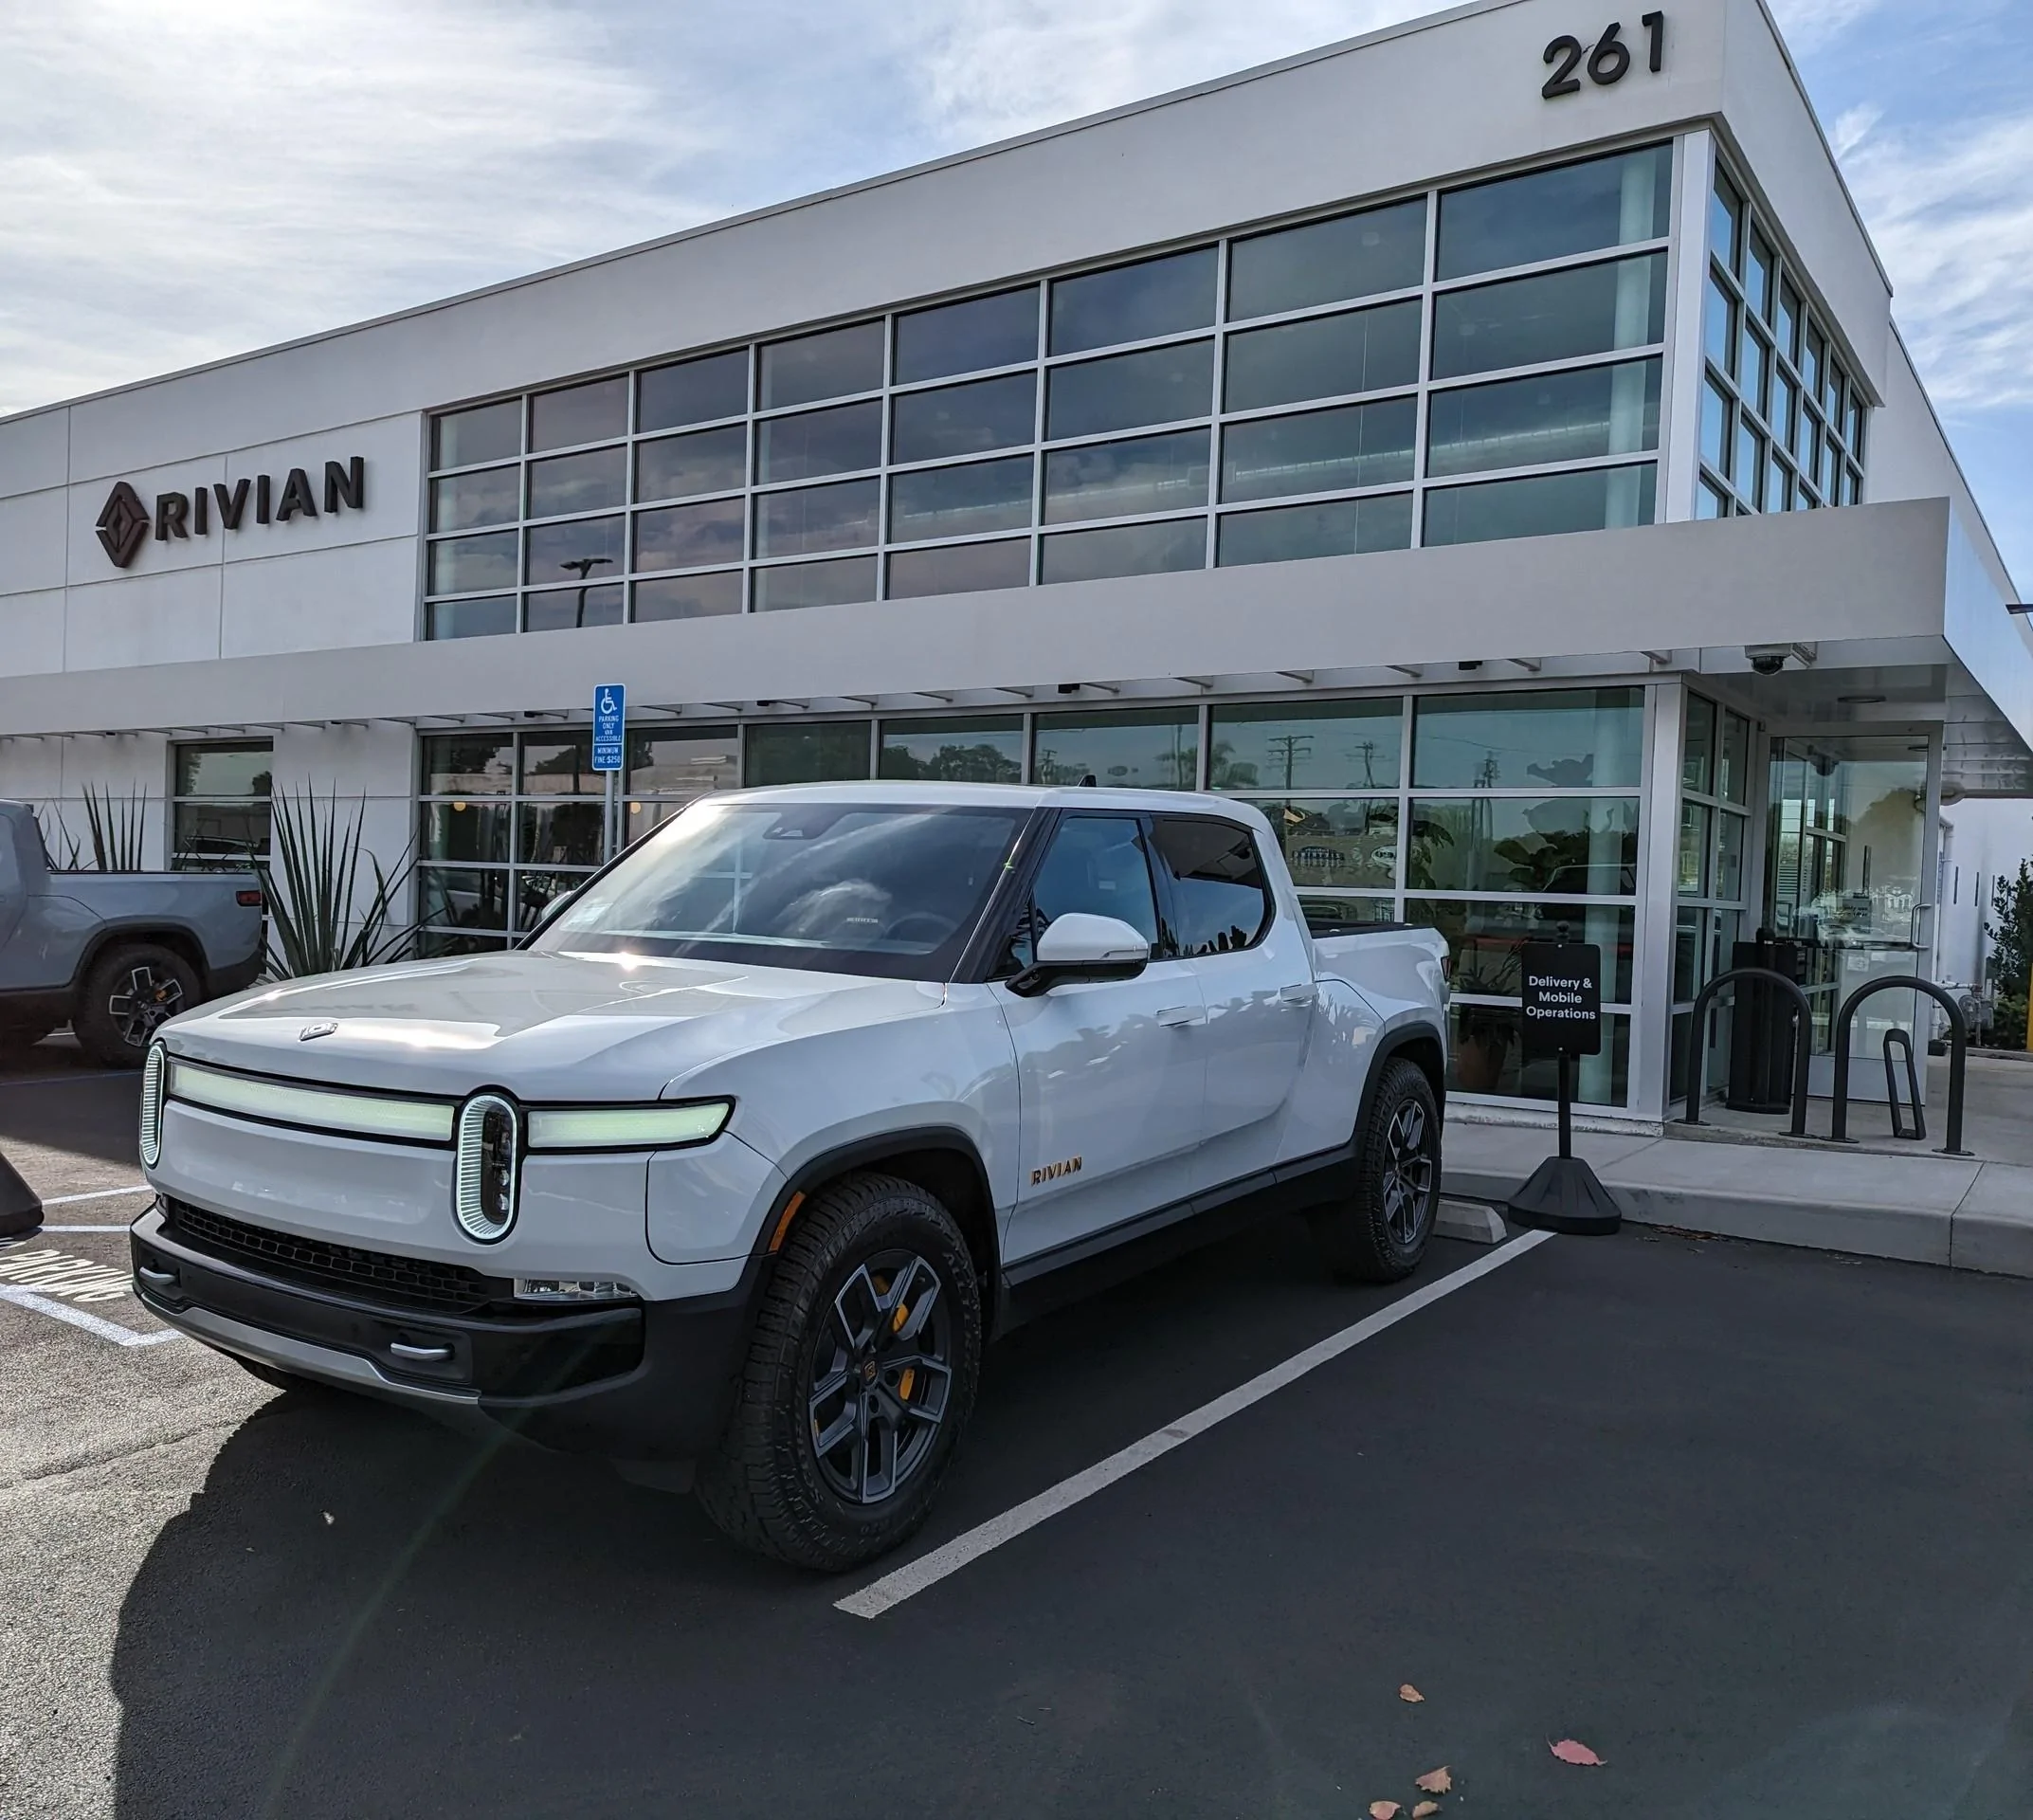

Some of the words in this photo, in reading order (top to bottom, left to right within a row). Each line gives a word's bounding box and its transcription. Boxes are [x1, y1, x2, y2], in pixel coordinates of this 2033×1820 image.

[1542, 10, 1664, 100] 261
[155, 456, 364, 541] RIVIAN
[597, 746, 619, 755] MINIMUM
[595, 755, 606, 764] FINE
[607, 755, 621, 764] $250
[1528, 975, 1581, 991] Delivery
[1583, 977, 1593, 989] &
[1538, 991, 1583, 1004] Mobile
[1526, 1006, 1596, 1020] Operations
[1030, 1156, 1082, 1187] RIVIAN
[0, 1248, 134, 1302] PARKING
